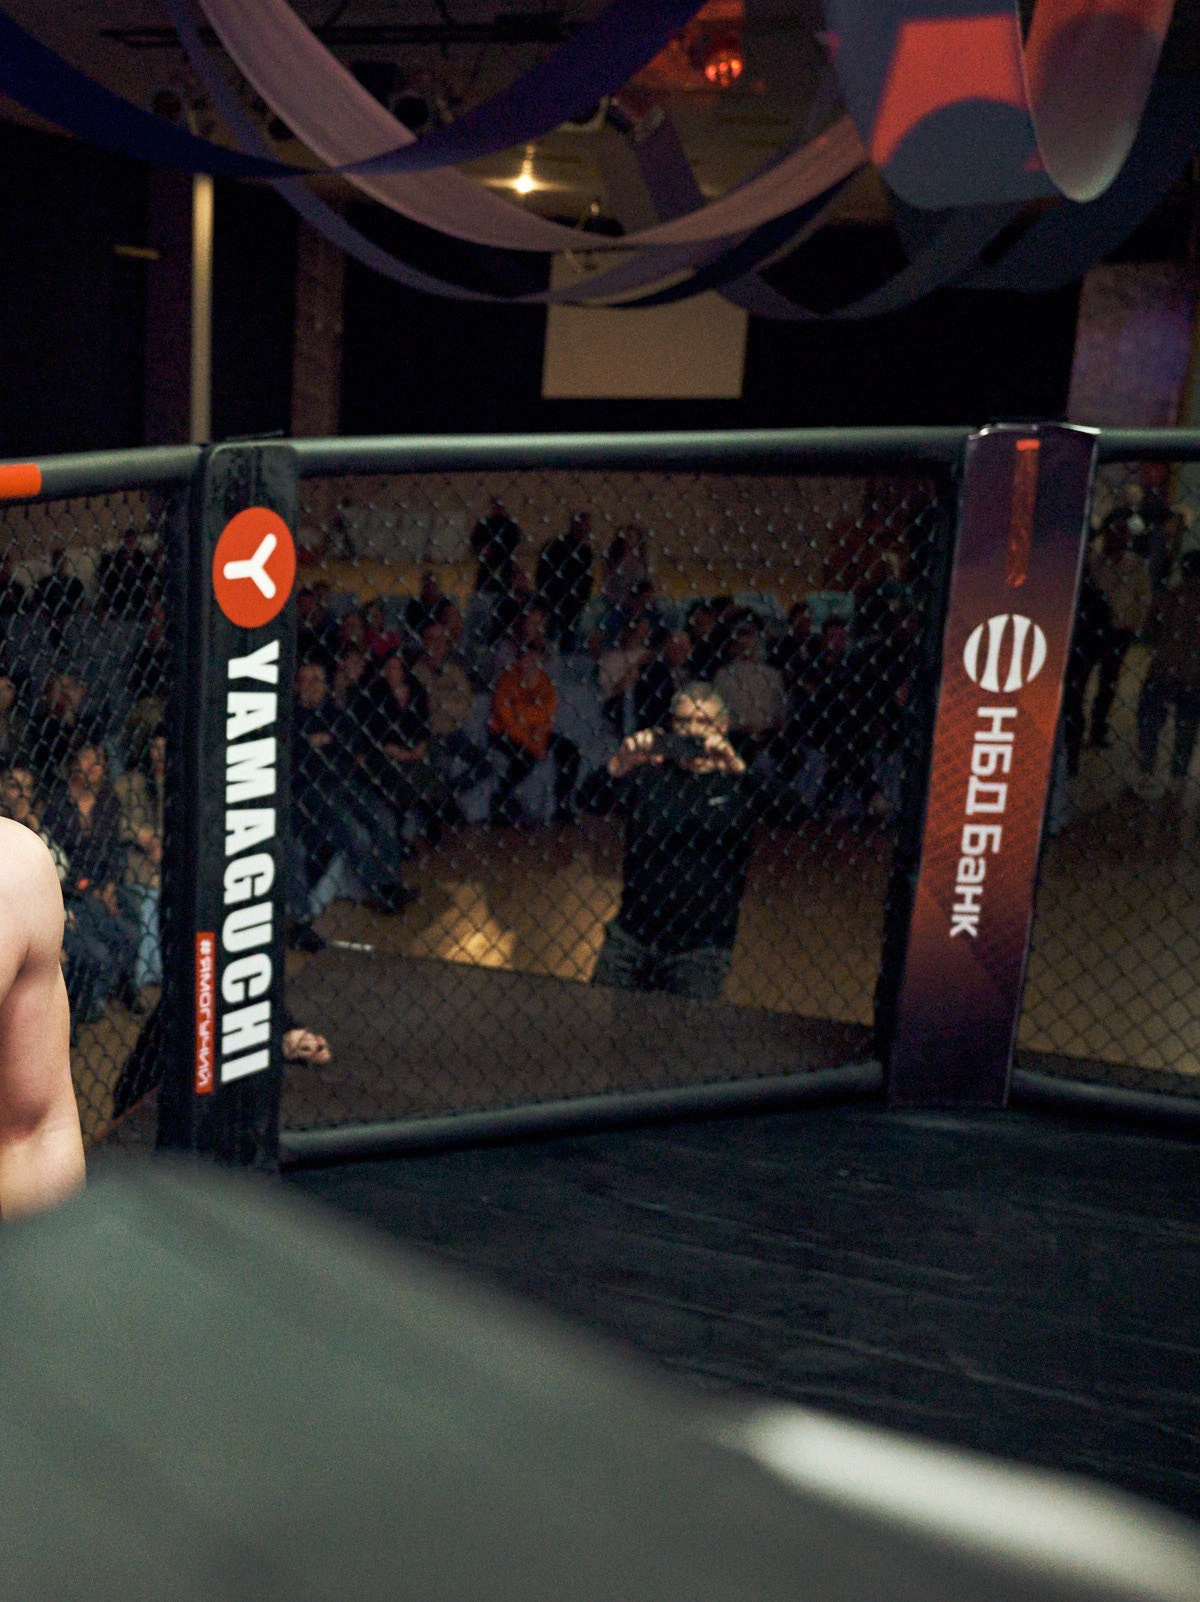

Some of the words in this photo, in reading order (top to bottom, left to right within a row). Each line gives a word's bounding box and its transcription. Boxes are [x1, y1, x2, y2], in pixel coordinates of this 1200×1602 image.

[224, 533, 277, 599] Y
[966, 707, 1017, 815] НБД
[222, 640, 279, 1082] YAMAGUCHI
[950, 824, 1001, 936] Банк
